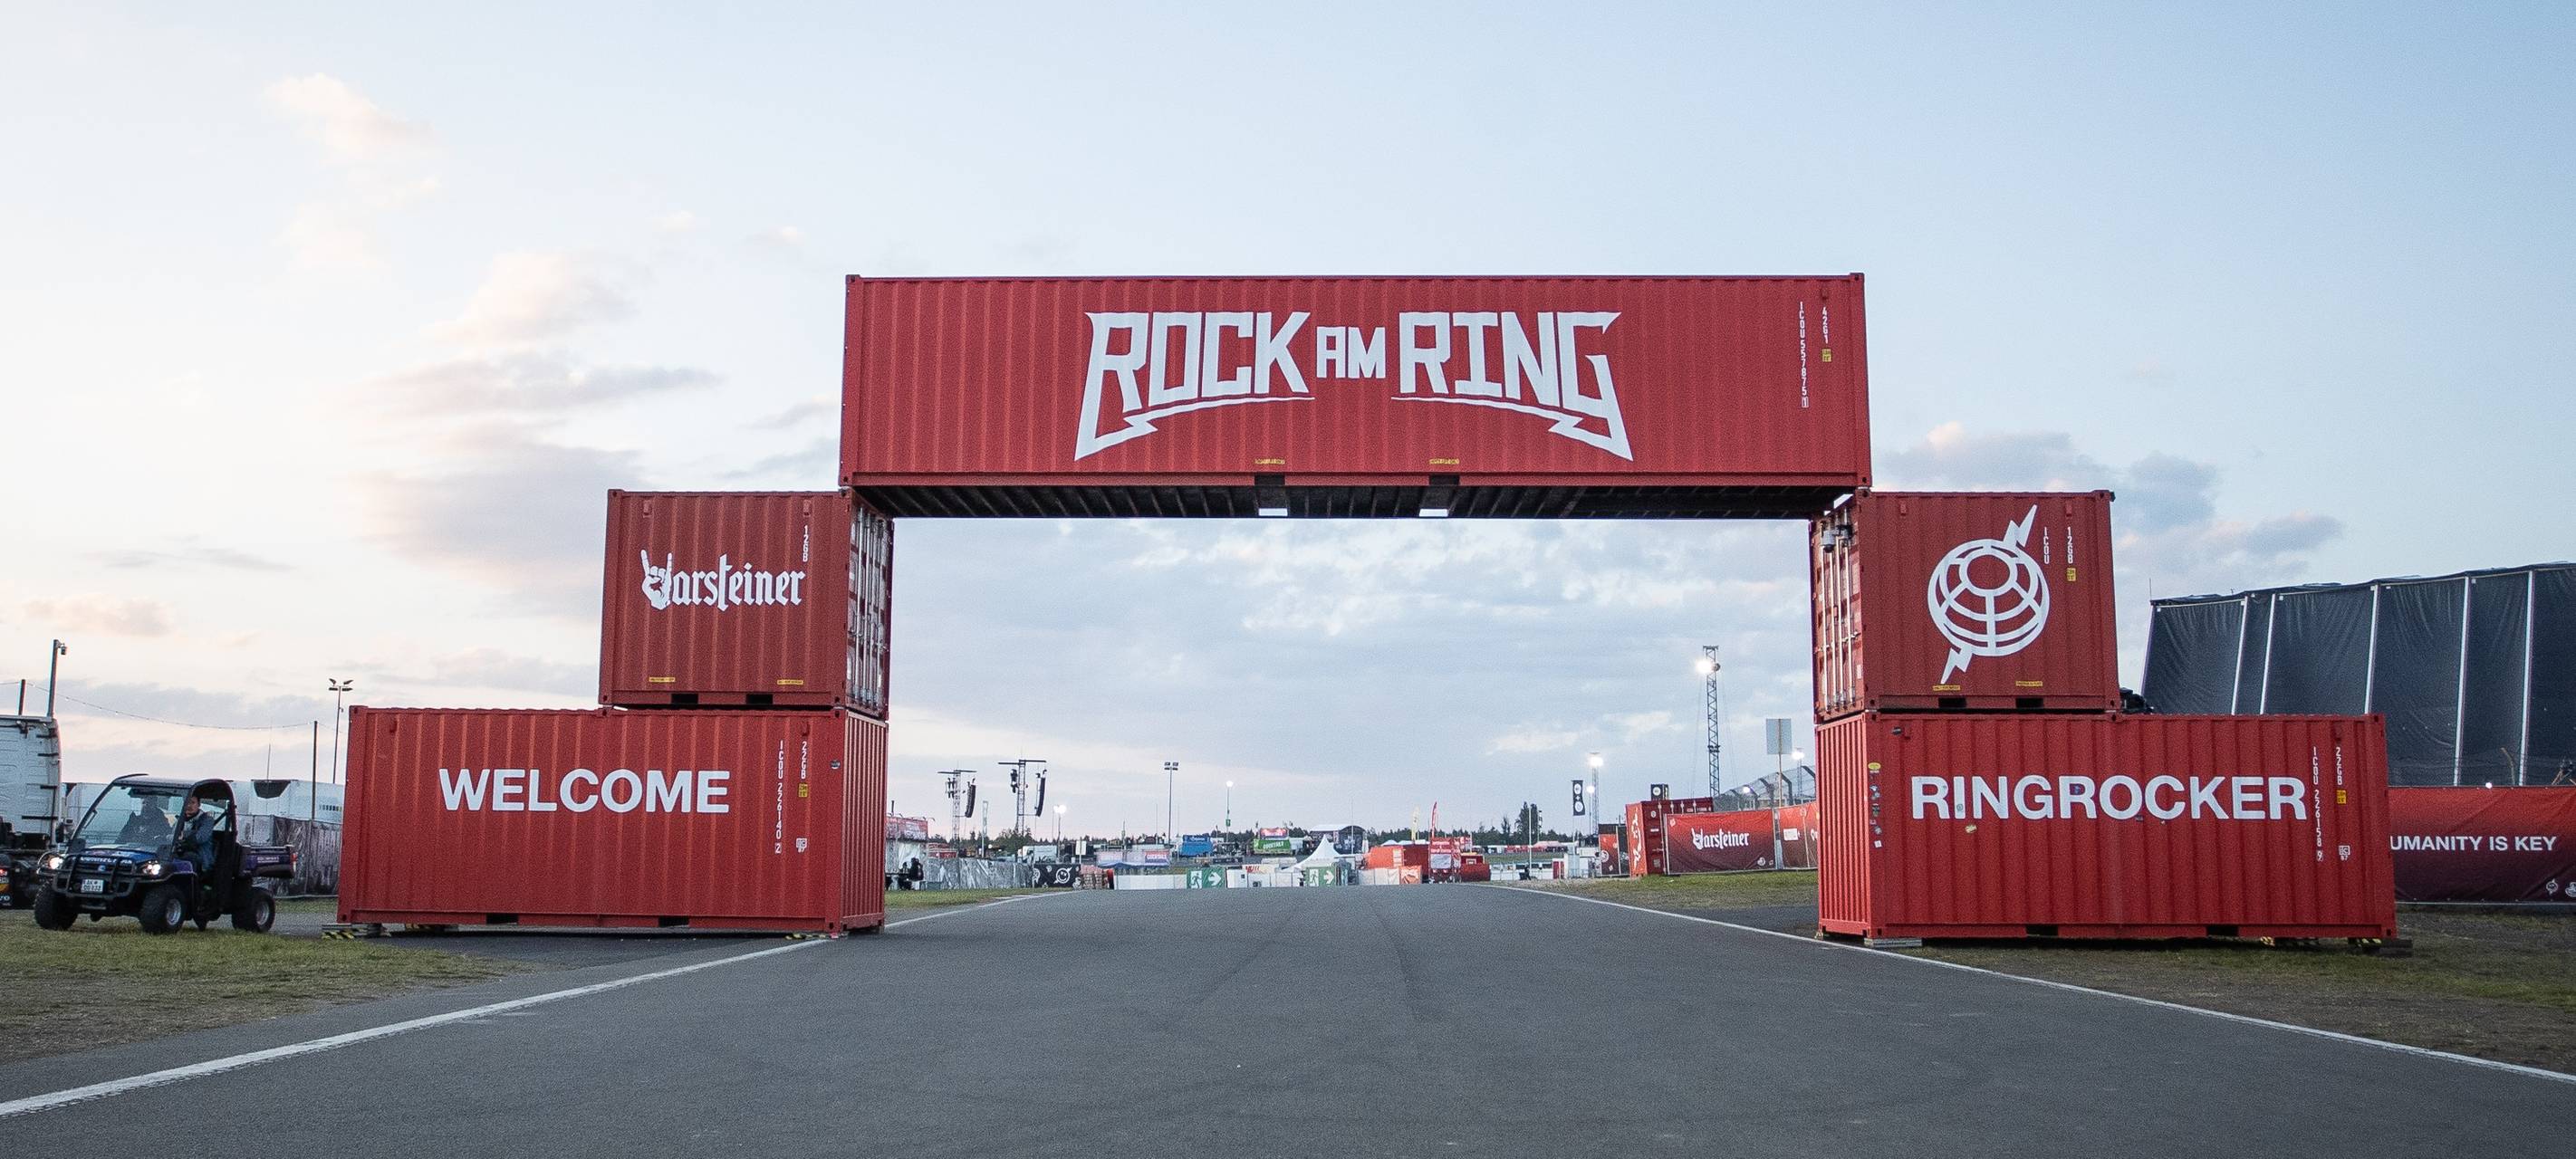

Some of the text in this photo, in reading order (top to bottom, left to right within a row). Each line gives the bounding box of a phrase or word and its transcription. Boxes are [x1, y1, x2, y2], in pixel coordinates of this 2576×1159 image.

[1074, 311, 1634, 462] ROCK AM RING
[438, 768, 730, 813] WELCOME
[1910, 775, 2307, 820] RINGROCKER
[2389, 835, 2557, 851] UMANITY IS KEY
